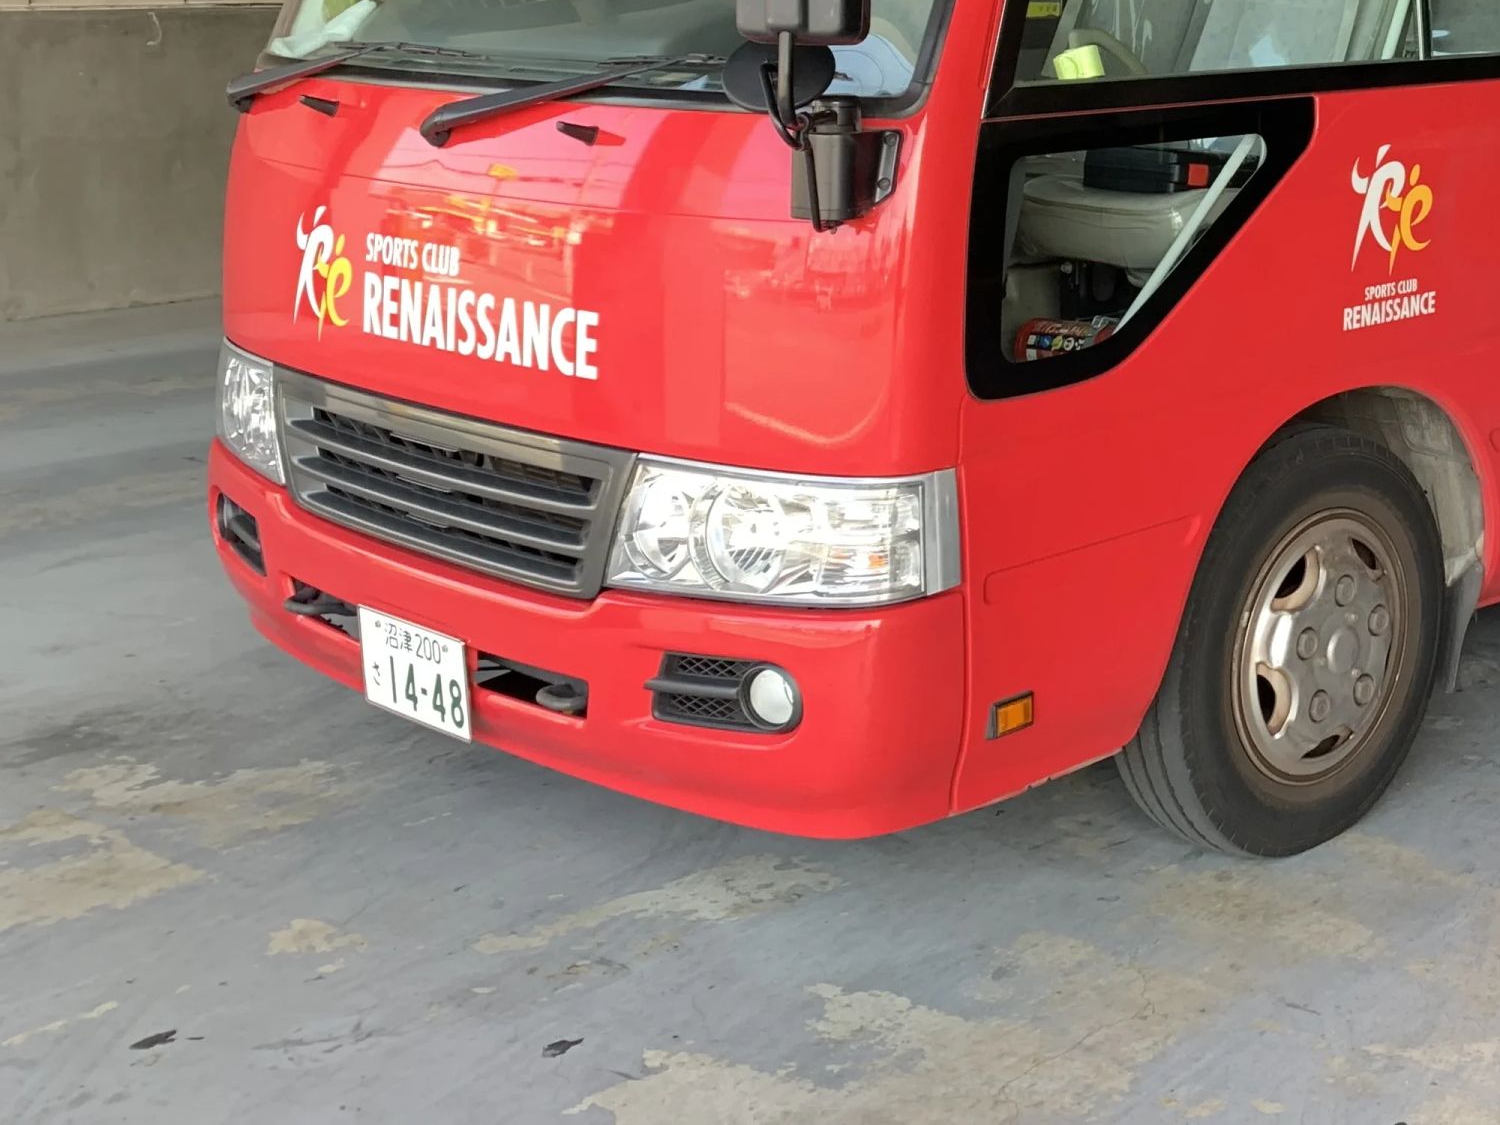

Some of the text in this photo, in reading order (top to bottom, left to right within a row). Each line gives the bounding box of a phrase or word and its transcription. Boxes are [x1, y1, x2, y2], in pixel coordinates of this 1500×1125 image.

[366, 232, 460, 277] SPORTS CLUB
[1342, 291, 1436, 332] RENAISSANCE
[1364, 278, 1418, 302] SPORTS CLUB
[362, 271, 599, 381] RENAISSANCE
[389, 655, 464, 729] 14-48
